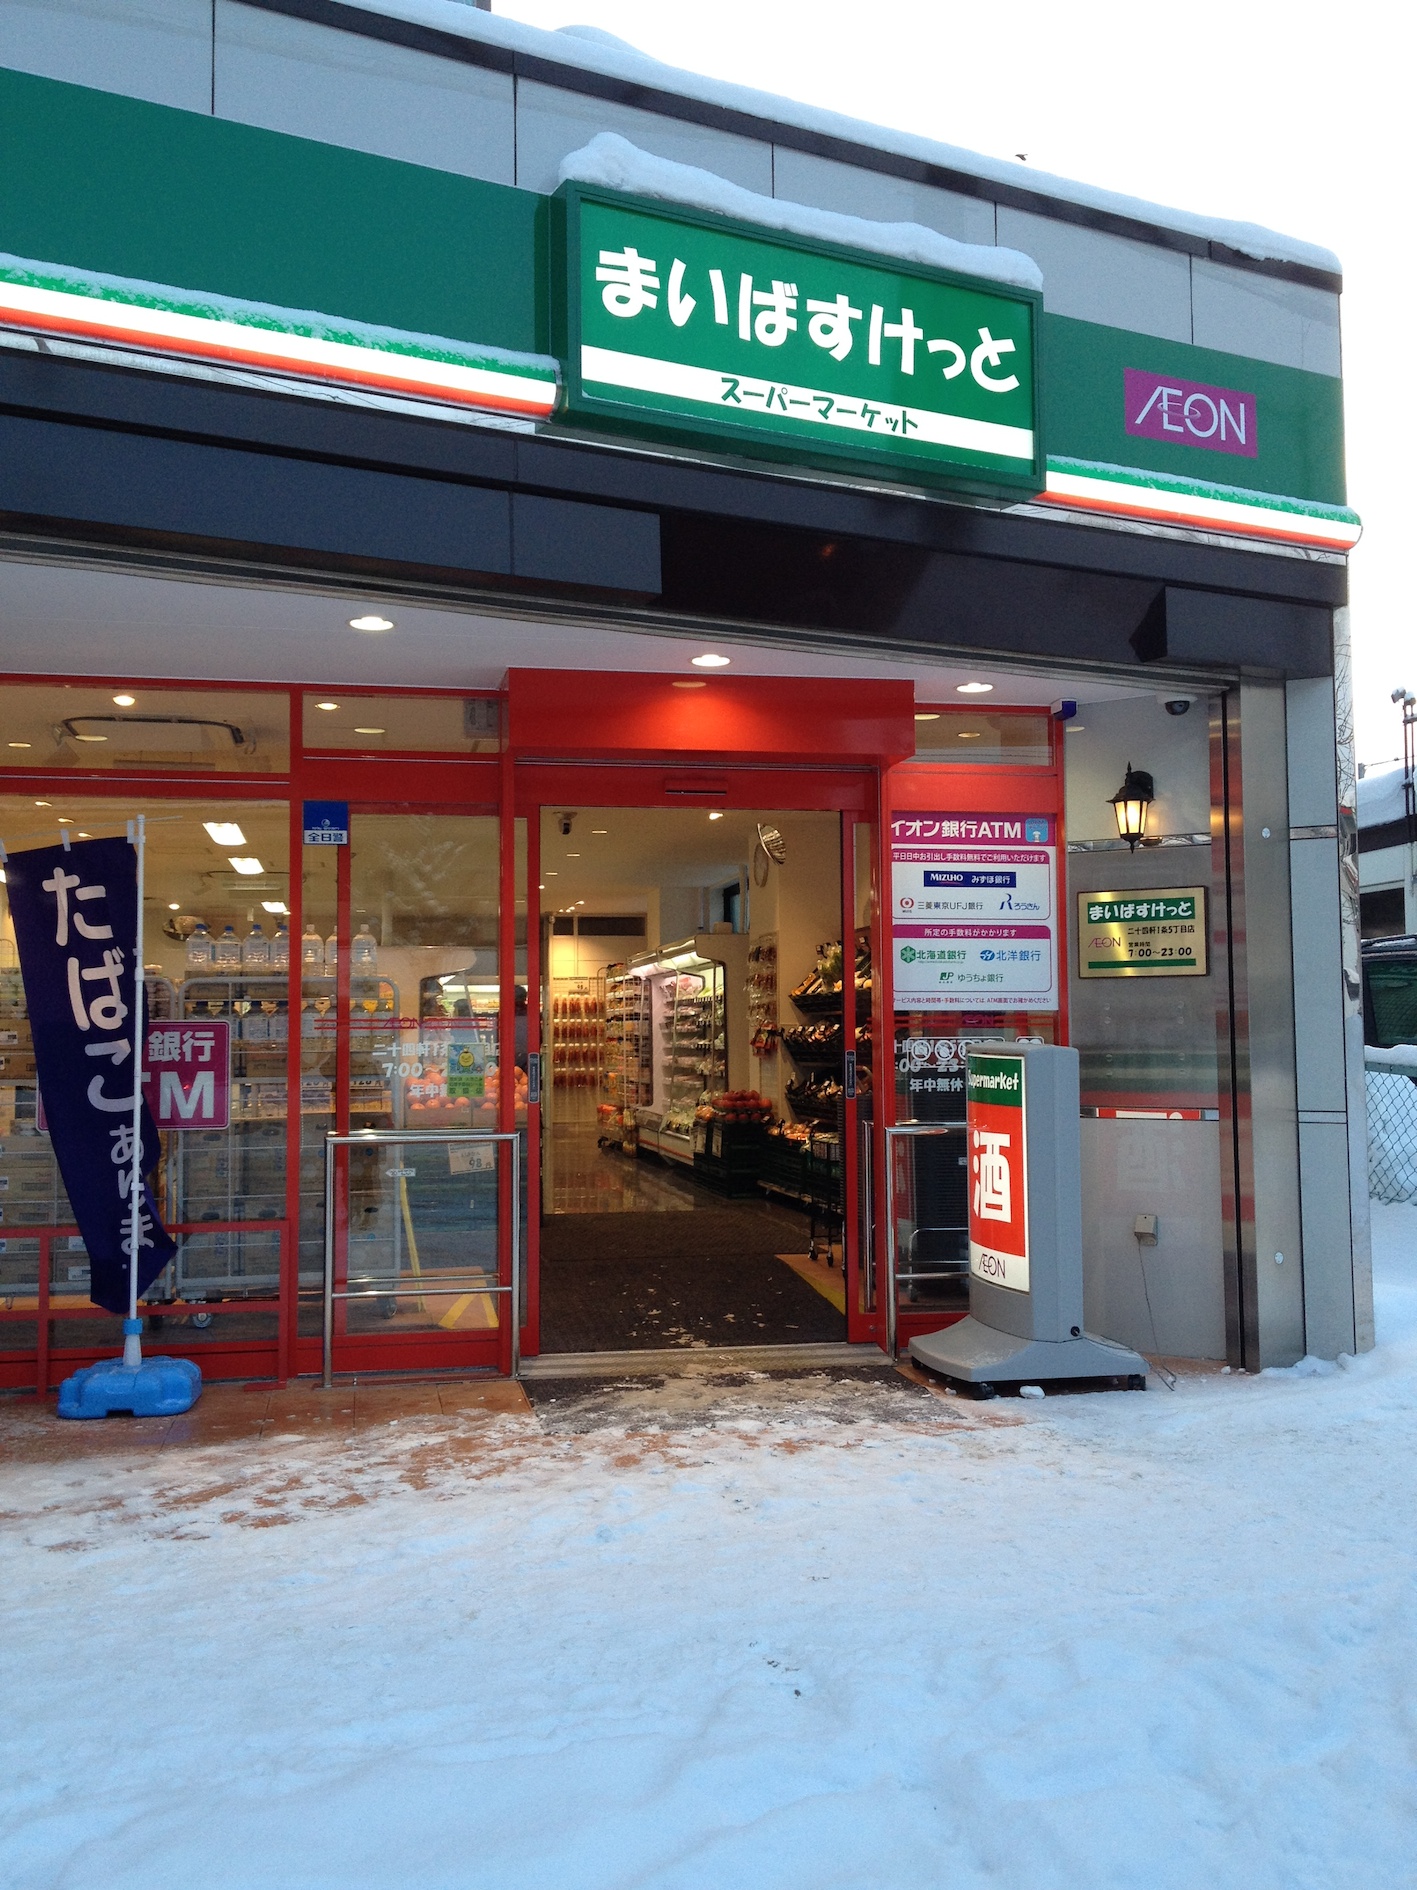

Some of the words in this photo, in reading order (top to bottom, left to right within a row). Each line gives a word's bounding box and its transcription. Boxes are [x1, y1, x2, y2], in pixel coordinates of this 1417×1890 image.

[595, 247, 1020, 392] まいばすけっと
[720, 377, 918, 435] スーパーマーケット
[891, 819, 1021, 839] イオン銀行ATM
[893, 852, 1046, 863] 平日日中お引出し手数料無料でご利用いただけます
[930, 873, 963, 881] MIZUHO
[971, 874, 1010, 884] みずほ銀行
[917, 901, 983, 910] 三菱東京UFJ銀行
[1089, 902, 1192, 921] まいばすけっと
[924, 928, 1017, 937] 所定の手数料がかかります
[917, 950, 967, 960] 北海道銀行
[996, 950, 1041, 961] 北洋銀行
[957, 974, 1003, 982] ゆうちょ銀行
[42, 867, 143, 1112] たばこ
[909, 1077, 963, 1092] 年中無休
[973, 1130, 1011, 1223] 酒
